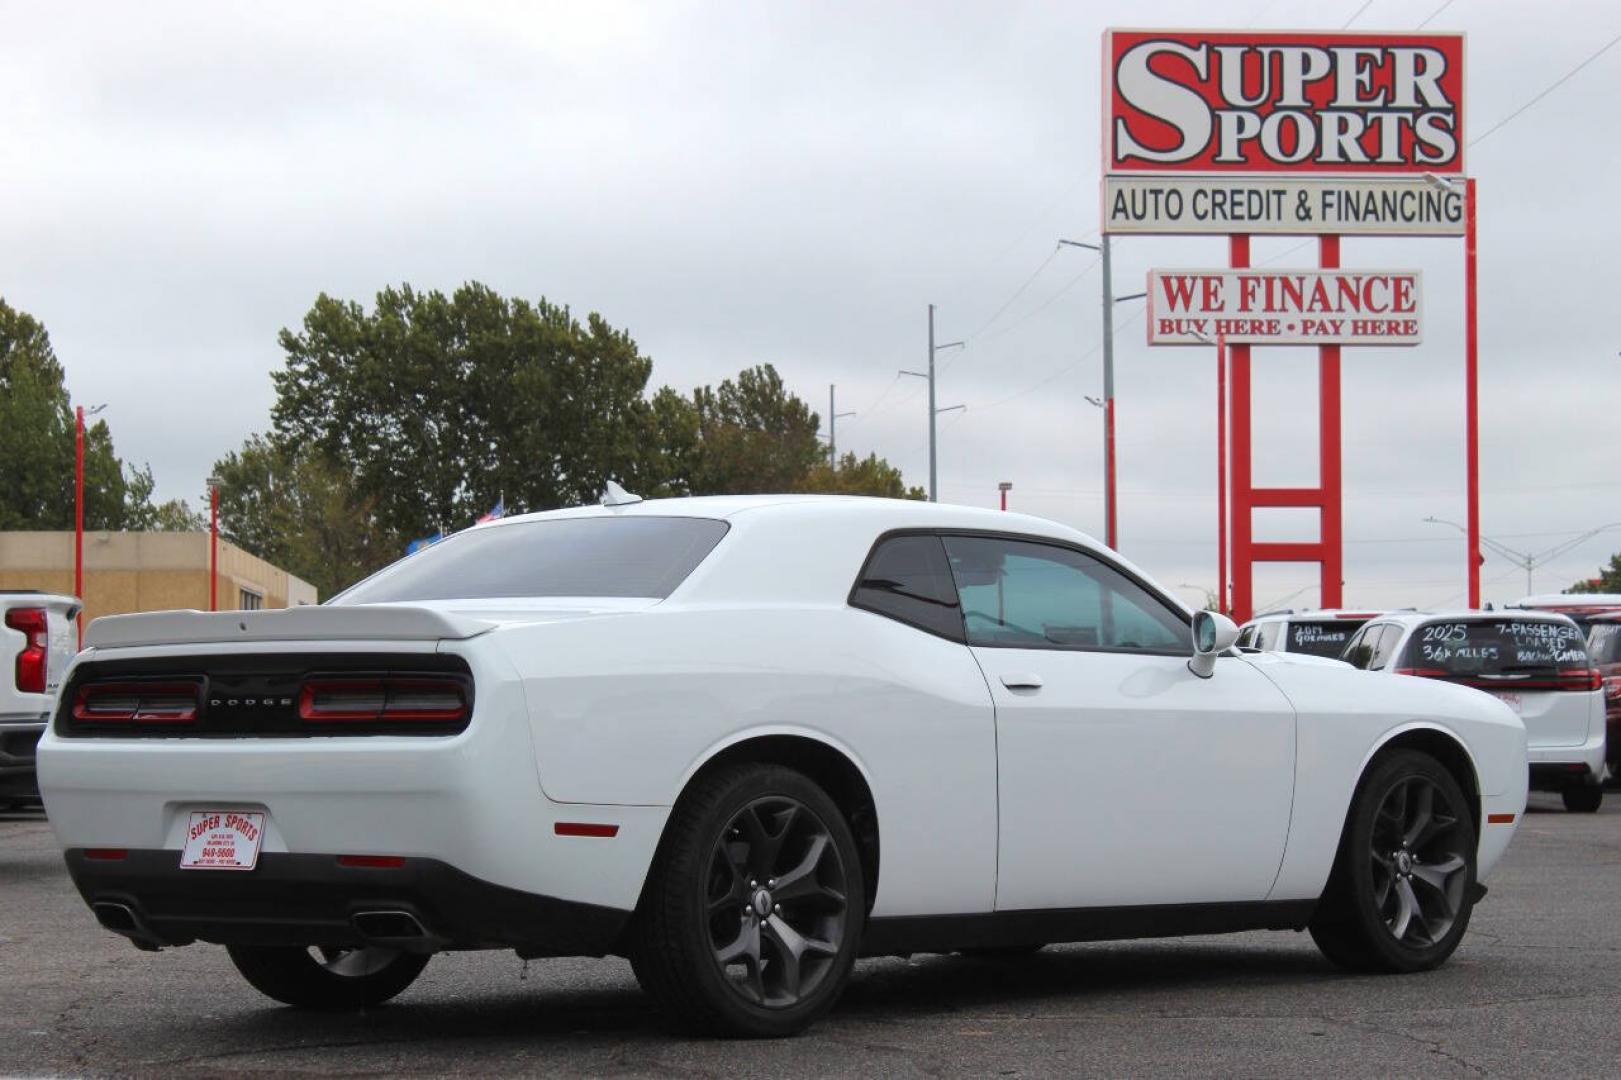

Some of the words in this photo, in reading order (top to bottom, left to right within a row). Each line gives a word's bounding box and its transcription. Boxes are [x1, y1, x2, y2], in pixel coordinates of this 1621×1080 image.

[1116, 38, 1454, 163] SUPER
[1112, 188, 1184, 221] AUTO
[1193, 188, 1286, 221] CREDIT
[1295, 189, 1313, 222] &
[1321, 188, 1462, 222] FINANCING
[1160, 276, 1224, 313] WE
[1237, 276, 1416, 314] FINANCE
[1158, 319, 1208, 335] BUY
[1215, 319, 1281, 335] HERE
[1302, 319, 1344, 335] PAY
[1351, 319, 1418, 336] HERE
[1422, 624, 1467, 641] 2025
[190, 815, 220, 840] SUPER
[225, 814, 258, 841] SPORTS
